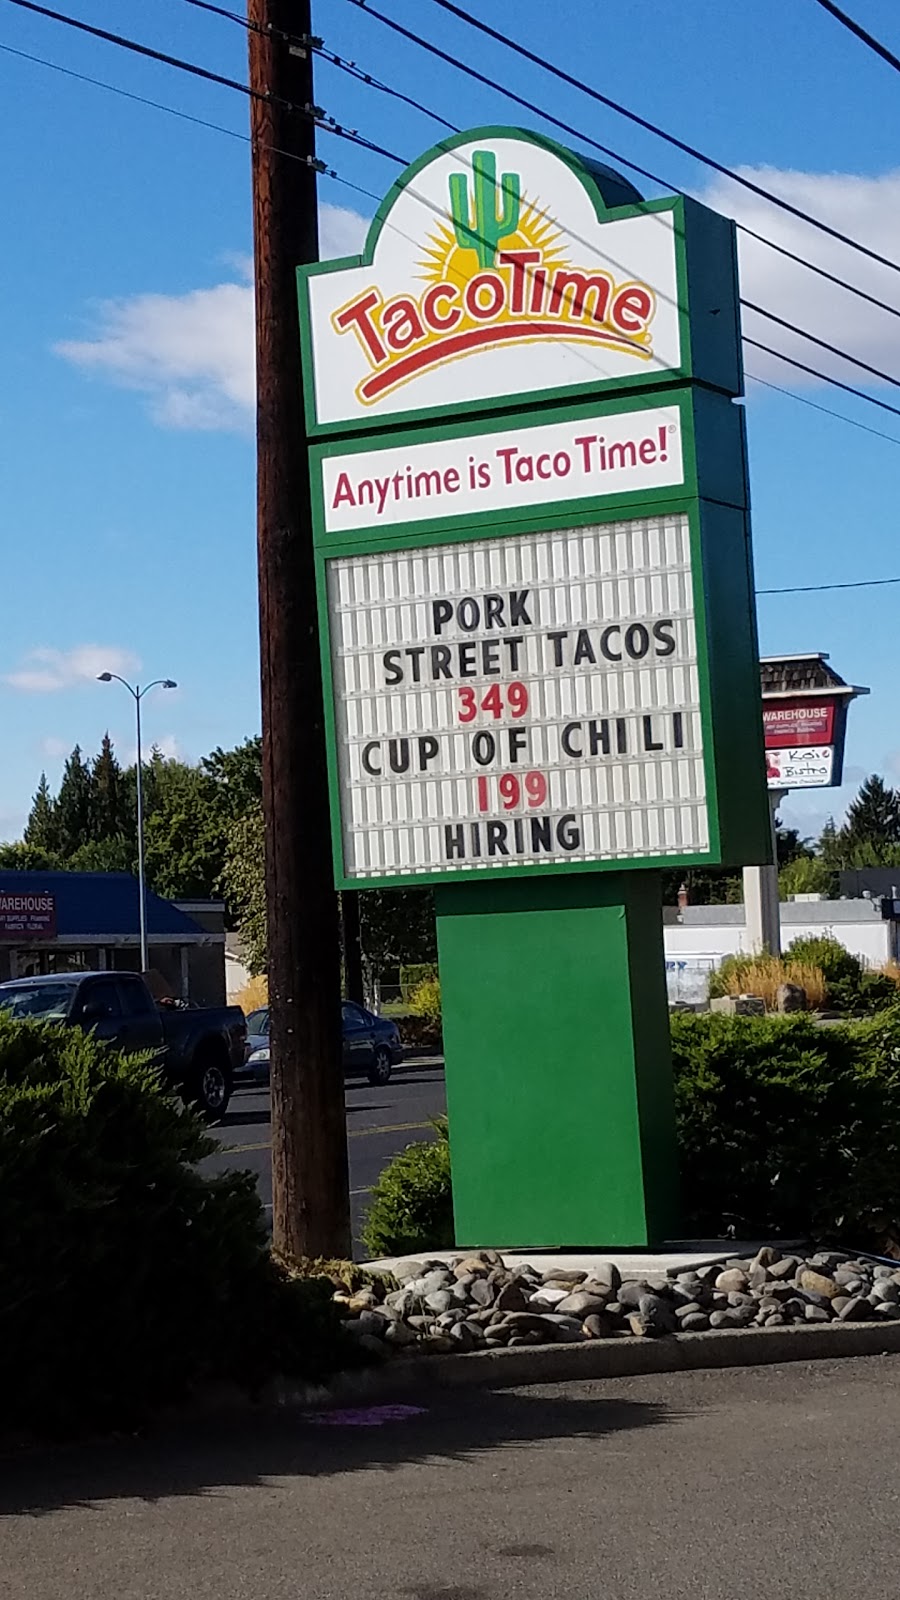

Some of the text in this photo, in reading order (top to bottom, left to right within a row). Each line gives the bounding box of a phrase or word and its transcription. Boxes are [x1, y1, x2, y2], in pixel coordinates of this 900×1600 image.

[331, 466, 461, 514] Anytime
[469, 456, 491, 490] is
[496, 447, 571, 485] Taco
[433, 589, 533, 635] PORK
[383, 620, 676, 686] STREET TACOS
[457, 681, 529, 723] 349
[763, 708, 828, 722] WAREHOUSE
[362, 712, 684, 776] CUP OF CHILI
[782, 762, 828, 777] Bistro
[477, 771, 548, 813] 199
[445, 814, 581, 860] HIRING
[0, 897, 54, 911] AREHOUSE
